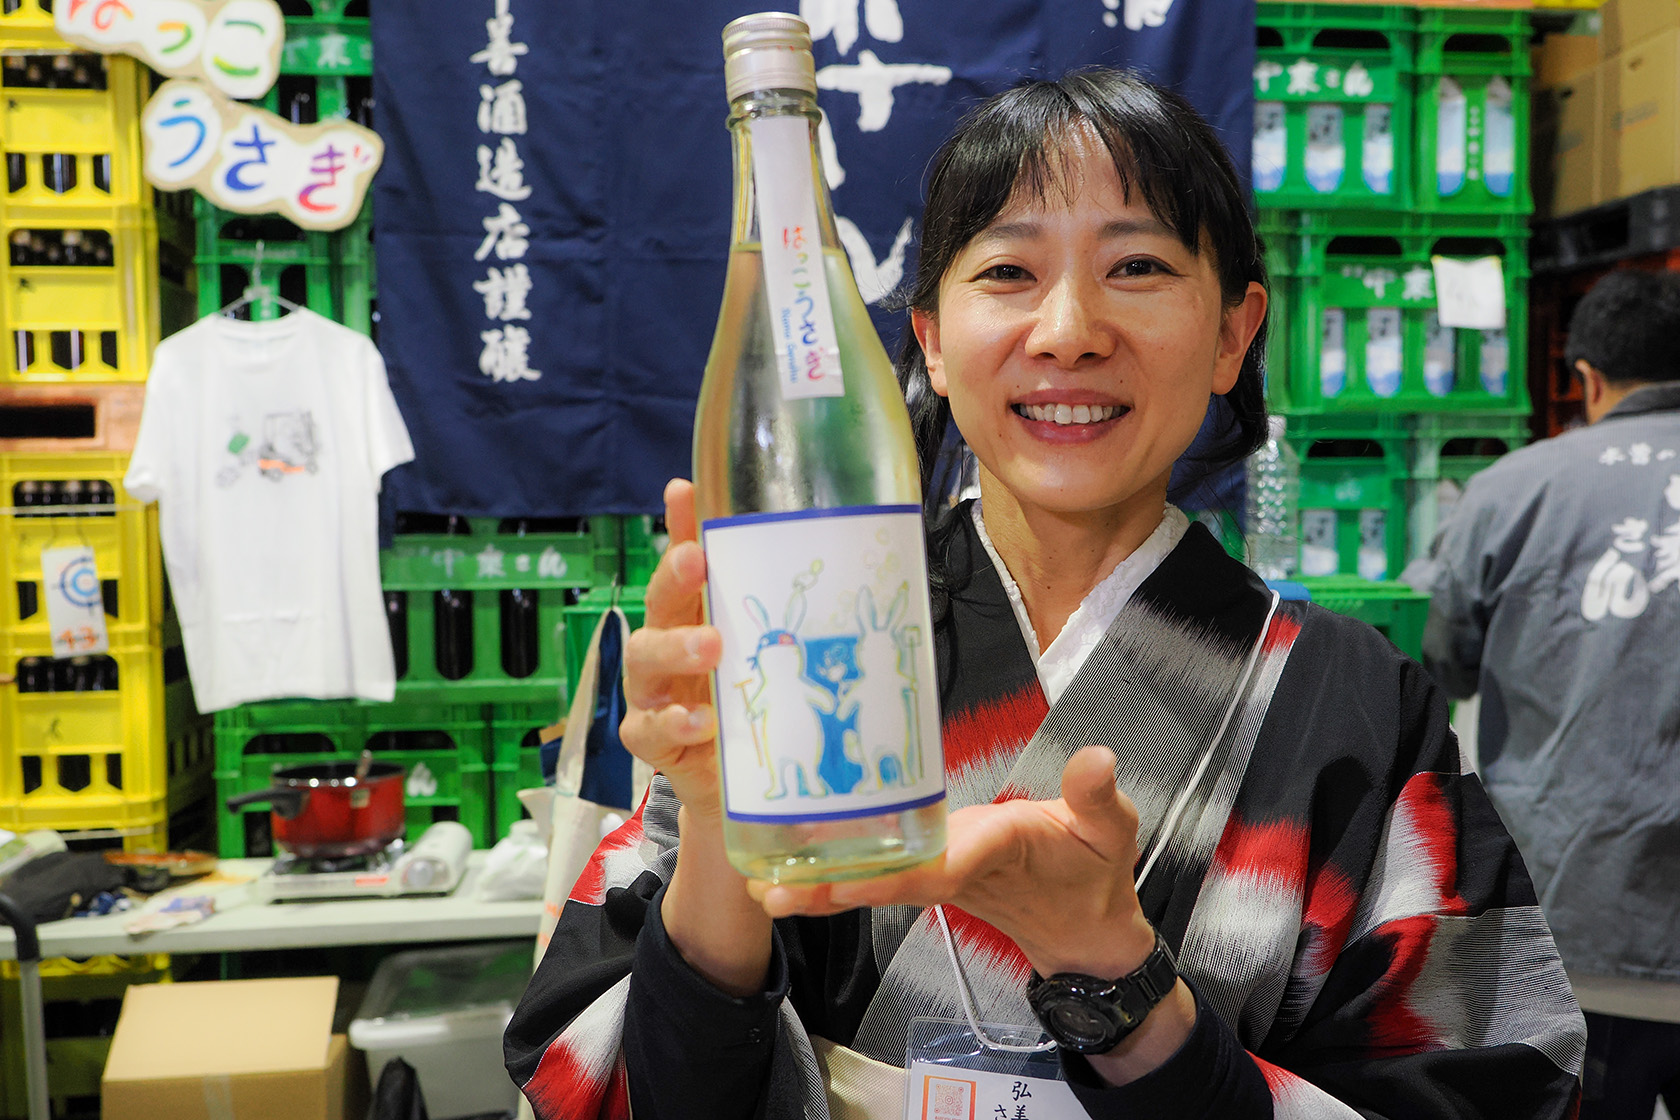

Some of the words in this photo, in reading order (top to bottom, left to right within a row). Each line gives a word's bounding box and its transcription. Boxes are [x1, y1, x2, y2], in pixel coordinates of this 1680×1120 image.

[158, 98, 371, 212] うさぎ
[782, 227, 826, 381] はっこうさぎ
[1011, 1080, 1032, 1120] 弘美
